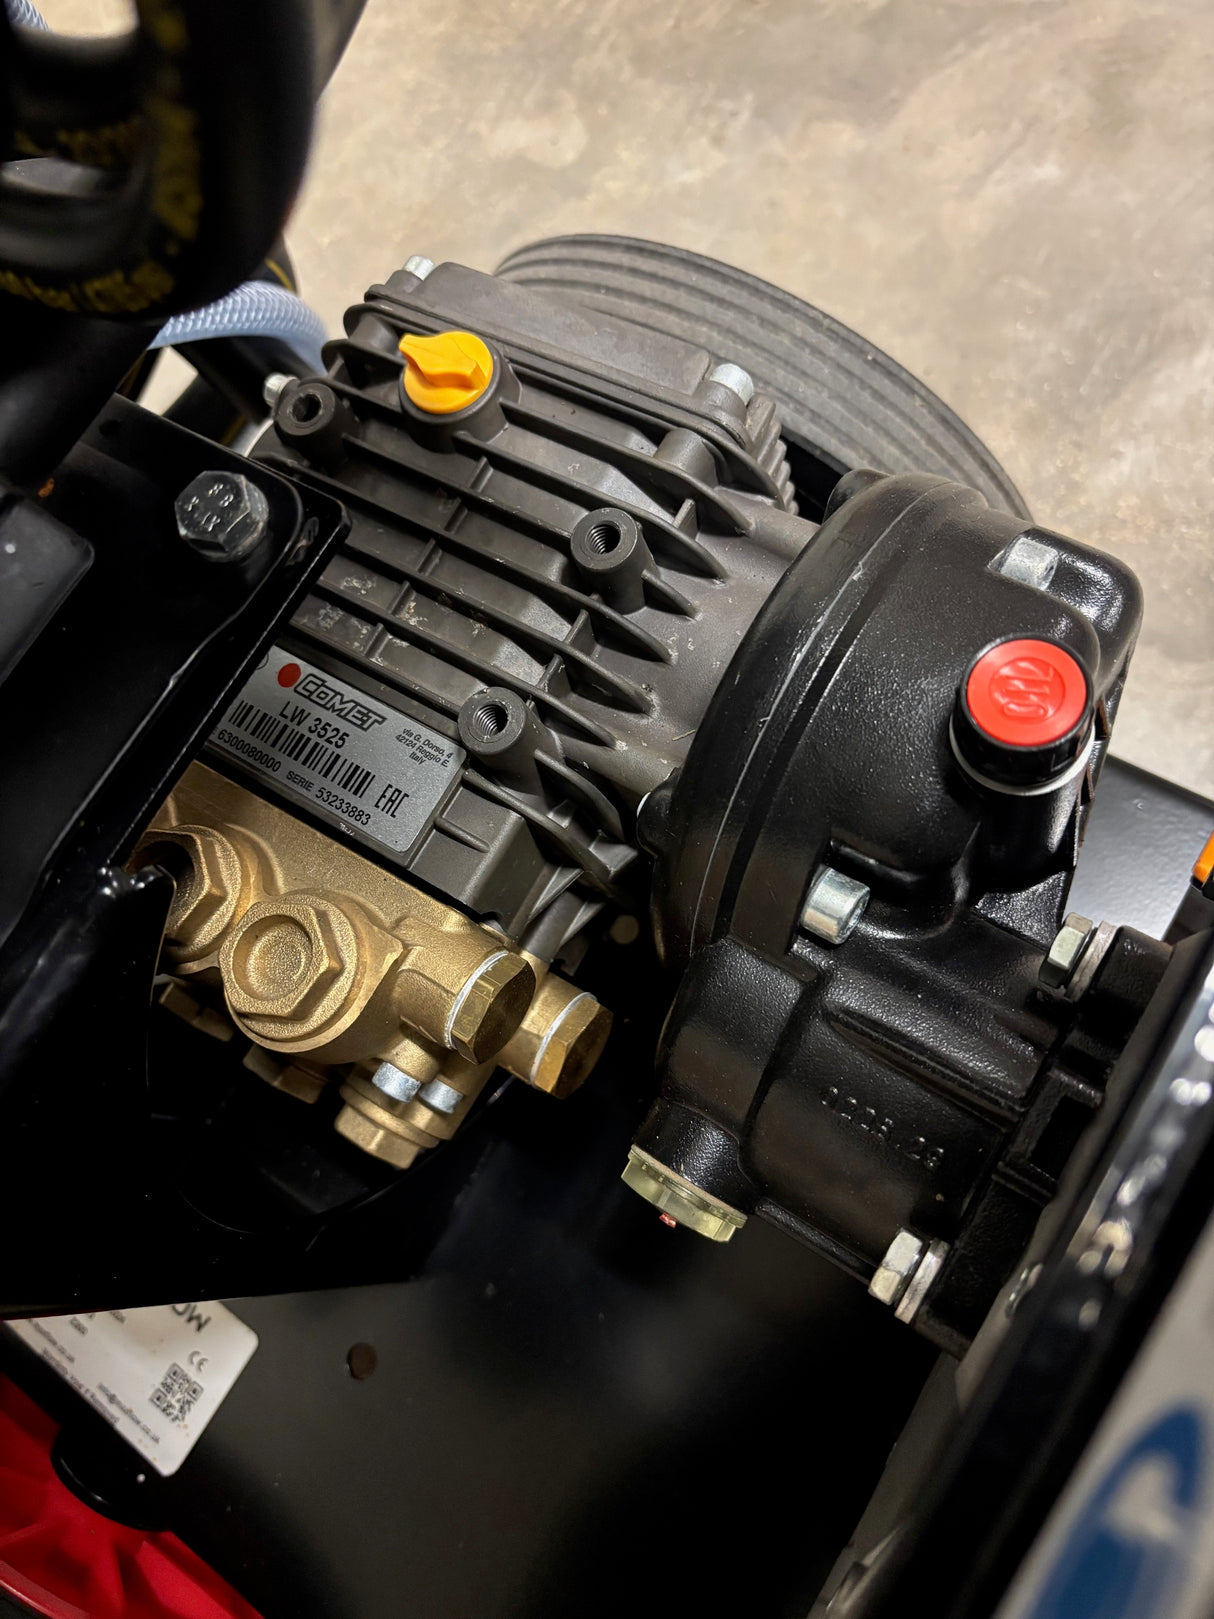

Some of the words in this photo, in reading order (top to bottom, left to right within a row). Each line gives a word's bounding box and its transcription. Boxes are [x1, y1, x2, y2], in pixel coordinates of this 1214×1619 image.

[279, 700, 311, 727] LW
[307, 716, 350, 750] 3525
[395, 734, 417, 749] 42124
[416, 745, 442, 763] Reggio
[403, 728, 414, 738] via
[413, 734, 423, 743] G.
[422, 739, 446, 756] Dorso,
[409, 752, 426, 765] Italy
[217, 728, 282, 773] 6300080000
[286, 770, 315, 792] SERIE
[315, 786, 372, 826] 53233883
[374, 783, 410, 819] EAC
